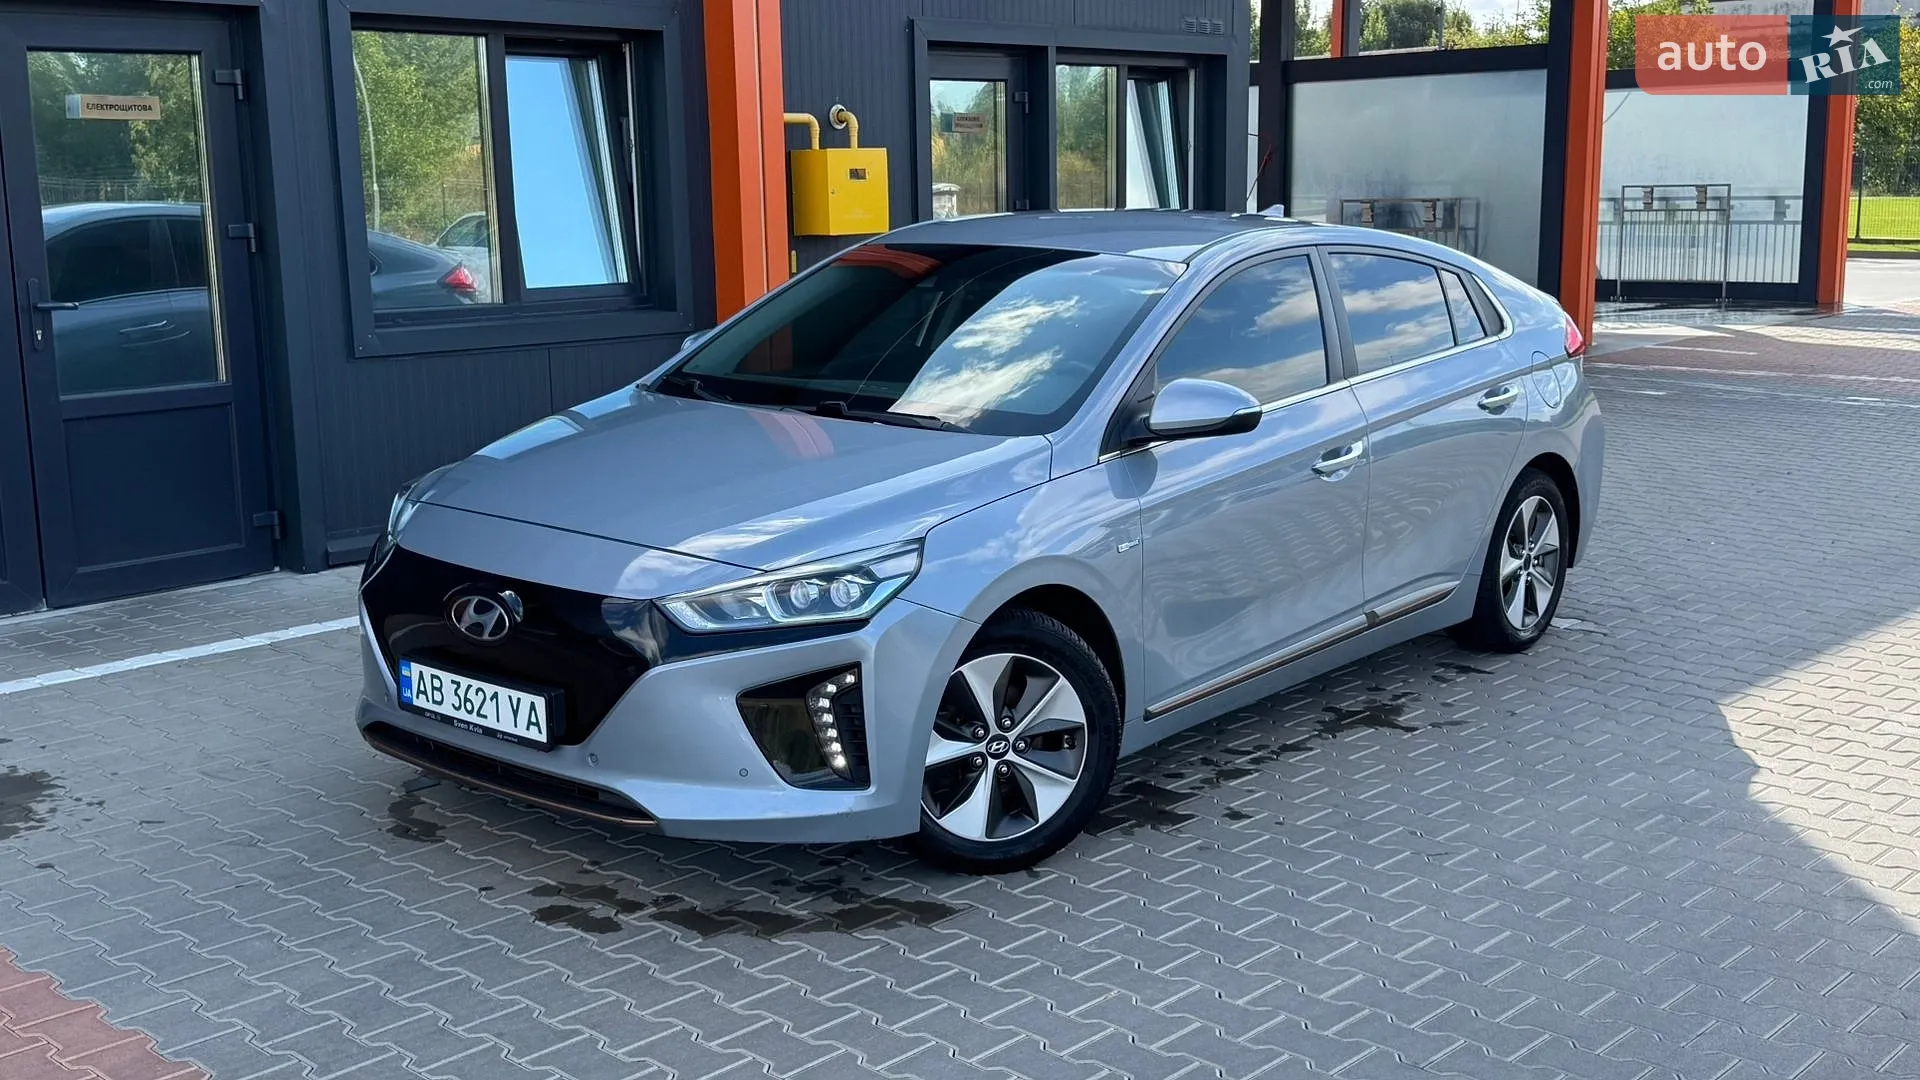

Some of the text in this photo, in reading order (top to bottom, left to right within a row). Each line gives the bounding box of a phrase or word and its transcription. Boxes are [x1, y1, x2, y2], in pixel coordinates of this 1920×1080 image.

[86, 102, 153, 112] ЕЛЕКТРОЩИТОВА
[402, 687, 412, 698] UA
[415, 670, 543, 735] AB 3621 YA
